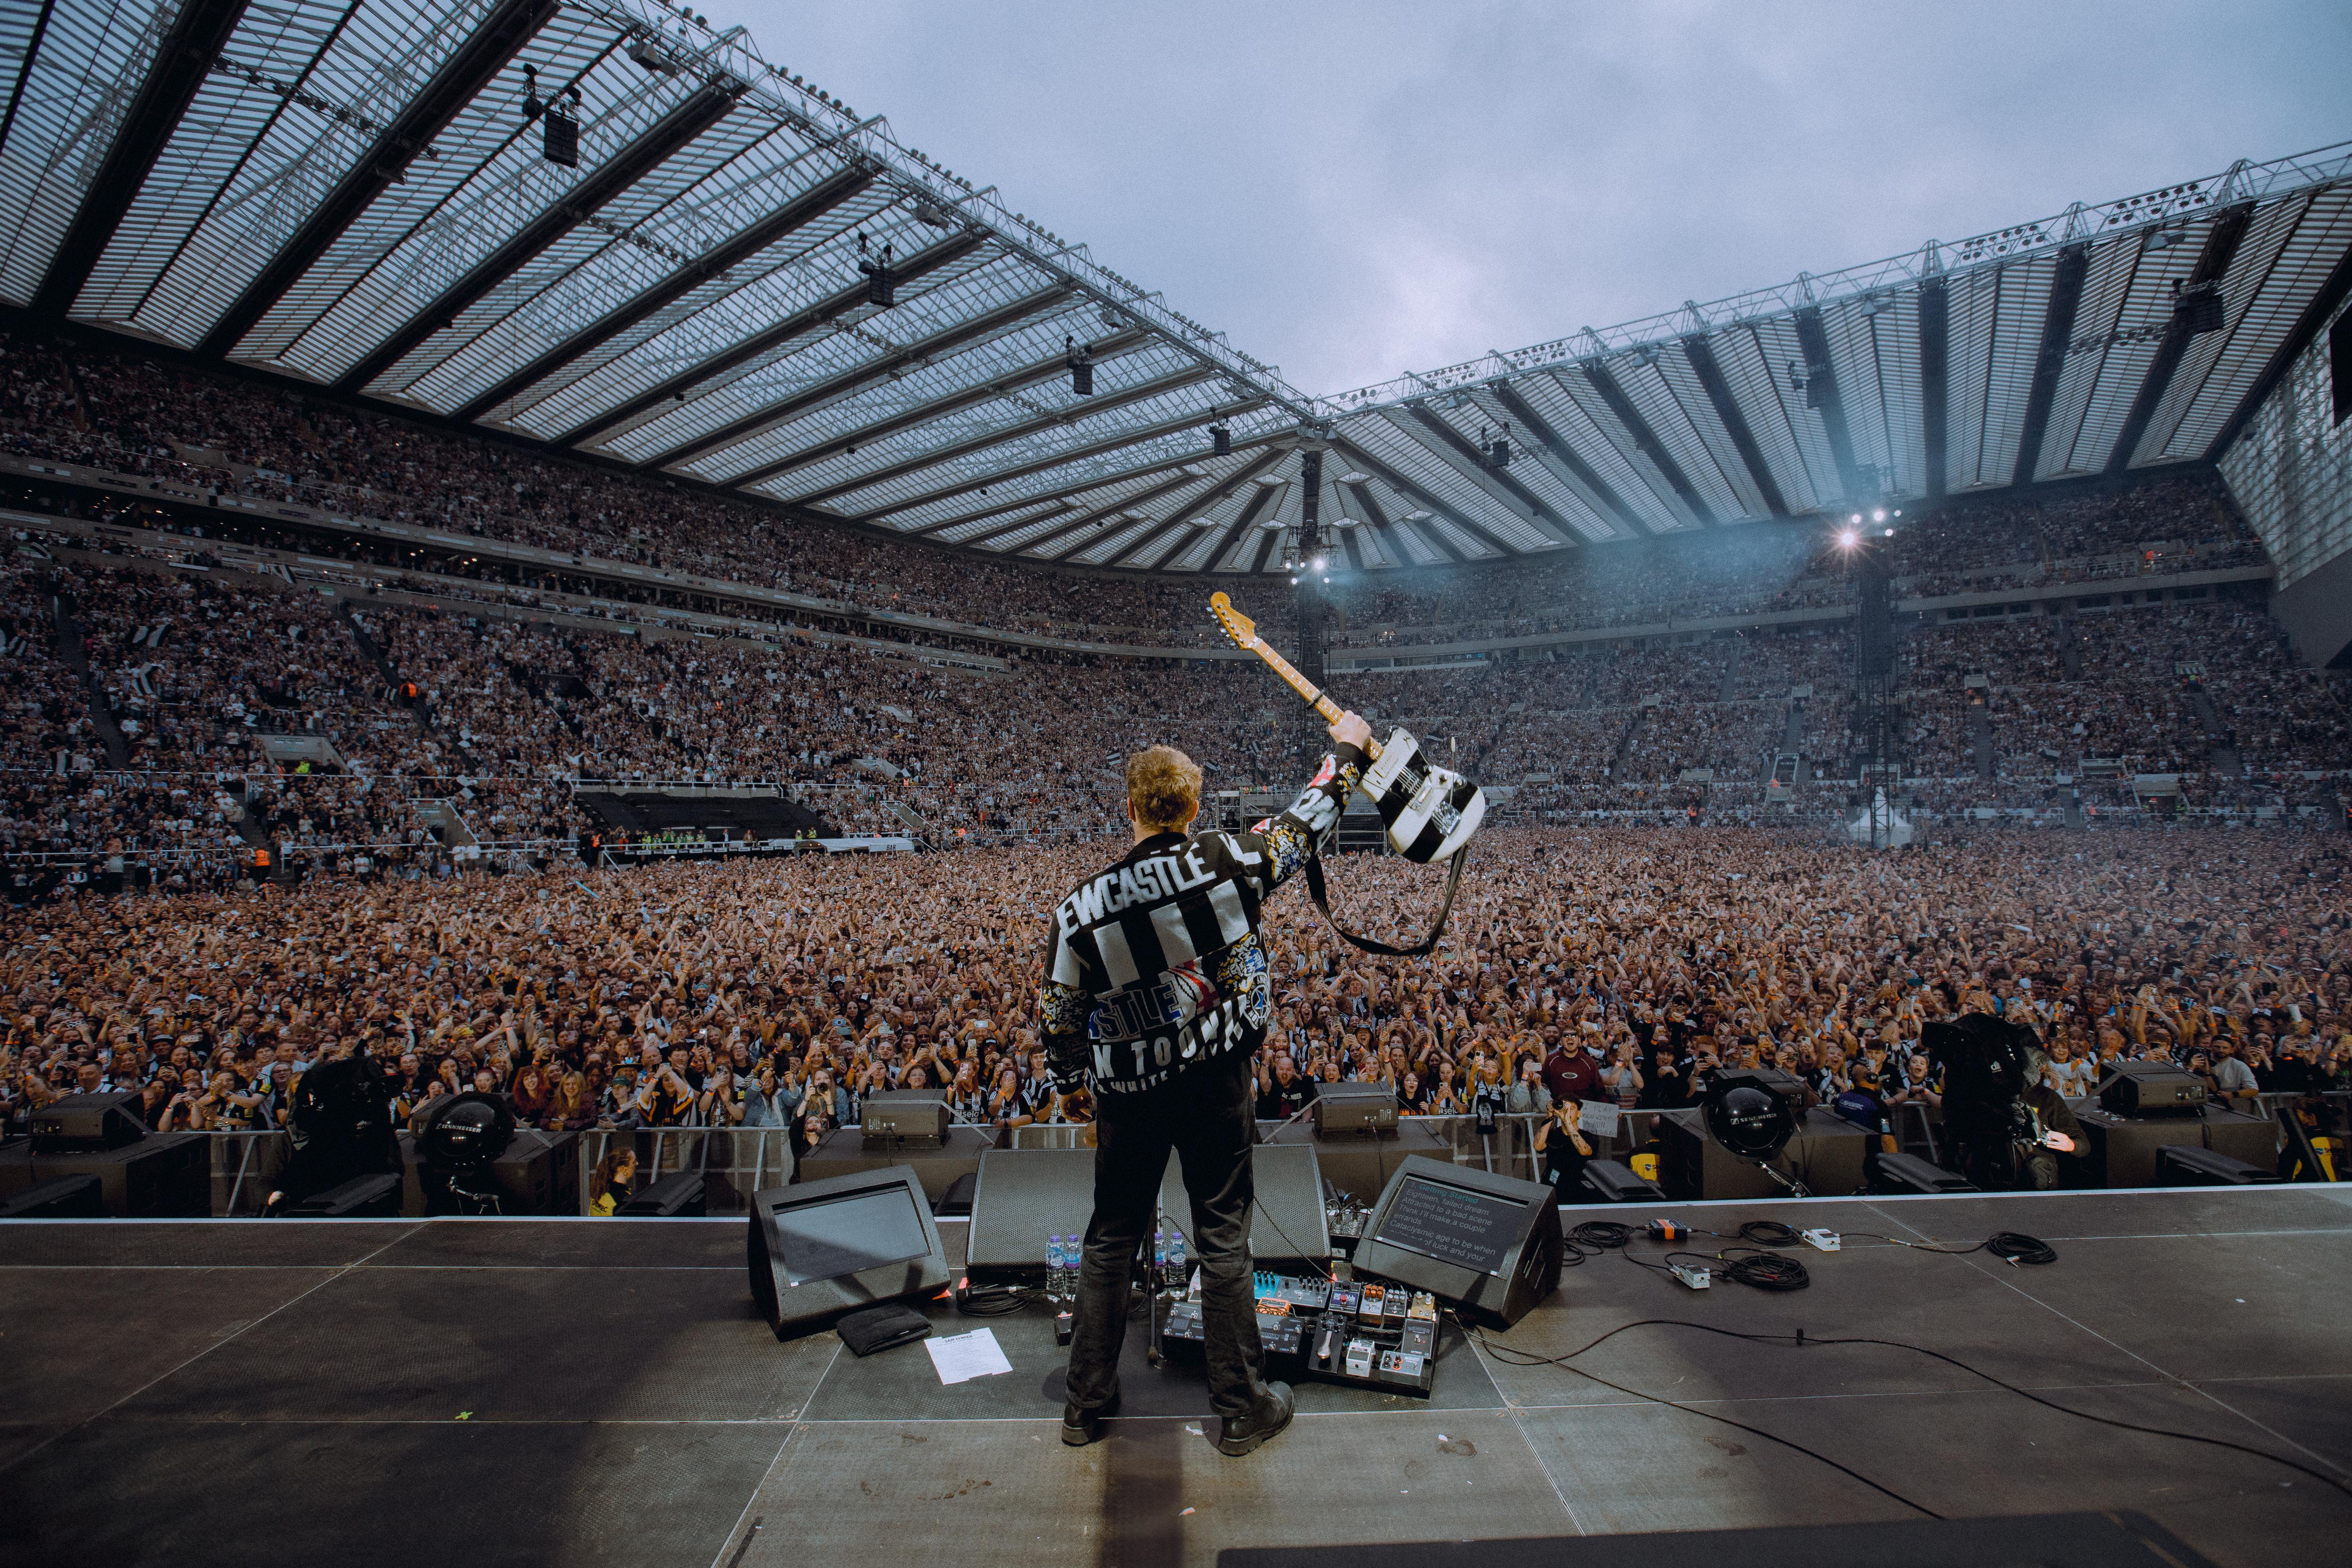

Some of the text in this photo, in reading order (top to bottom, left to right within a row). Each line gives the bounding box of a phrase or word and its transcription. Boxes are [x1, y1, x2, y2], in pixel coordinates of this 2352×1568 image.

[1089, 981, 1184, 1039] STLE
[1131, 1011, 1219, 1075] TOON
[1741, 1113, 1777, 1122] SENNHEISER
[442, 1124, 482, 1133] SENNHEISER
[1419, 1184, 1447, 1197] Getting
[1450, 1190, 1478, 1203] Started
[1402, 1197, 1434, 1210] Attracted
[1452, 1210, 1467, 1219] bad
[1469, 1215, 1493, 1226] scene
[1442, 1198, 1462, 1210] failed
[1464, 1203, 1489, 1216] dream
[1394, 1213, 1422, 1225] errands
[1399, 1204, 1418, 1216] Think
[1430, 1213, 1450, 1224] make
[1459, 1221, 1485, 1234] couple
[1390, 1220, 1434, 1238] Cataclysmic
[1435, 1234, 1450, 1243] age
[1462, 1240, 1472, 1249] be
[1474, 1244, 1495, 1256] when
[1432, 1241, 1447, 1251] luck
[1450, 1247, 1465, 1256] and
[1466, 1252, 1486, 1262] your
